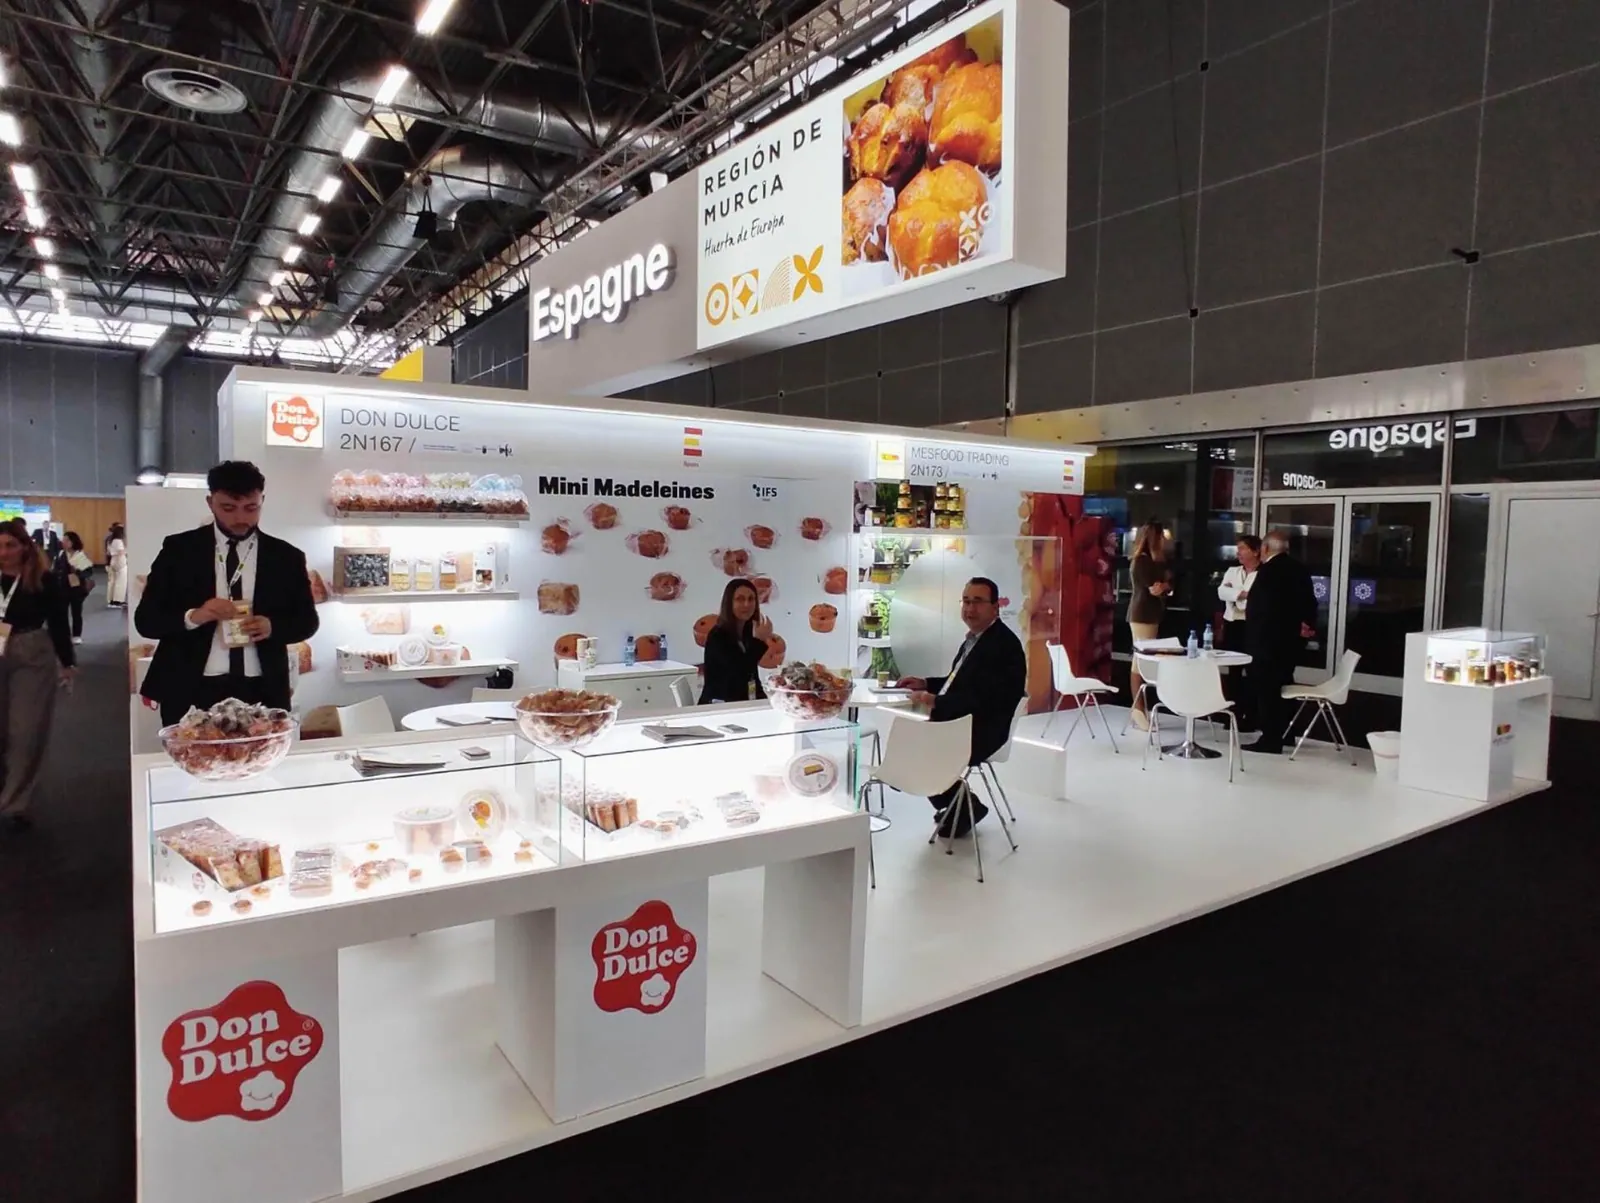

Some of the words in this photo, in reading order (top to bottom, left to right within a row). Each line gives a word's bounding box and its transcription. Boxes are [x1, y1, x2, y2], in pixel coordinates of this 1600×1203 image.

[704, 144, 781, 196] REGIÓN
[793, 118, 822, 151] DE
[704, 231, 735, 259] Huerta
[736, 224, 748, 244] de
[750, 213, 785, 239] Europa
[533, 243, 670, 341] Espagne
[341, 408, 387, 427] DON
[394, 412, 461, 432] DULCE
[340, 433, 403, 453] 2N167
[911, 447, 964, 462] MESFOOD
[967, 451, 1010, 466] TRADING
[911, 464, 943, 477] 2N173
[539, 476, 588, 496] Mini
[594, 478, 715, 499] Madeleines
[762, 487, 778, 497] IFS
[604, 925, 668, 955] Don
[602, 945, 689, 982] Dulce
[181, 1010, 279, 1051] Don
[180, 1034, 312, 1085] Dulce
